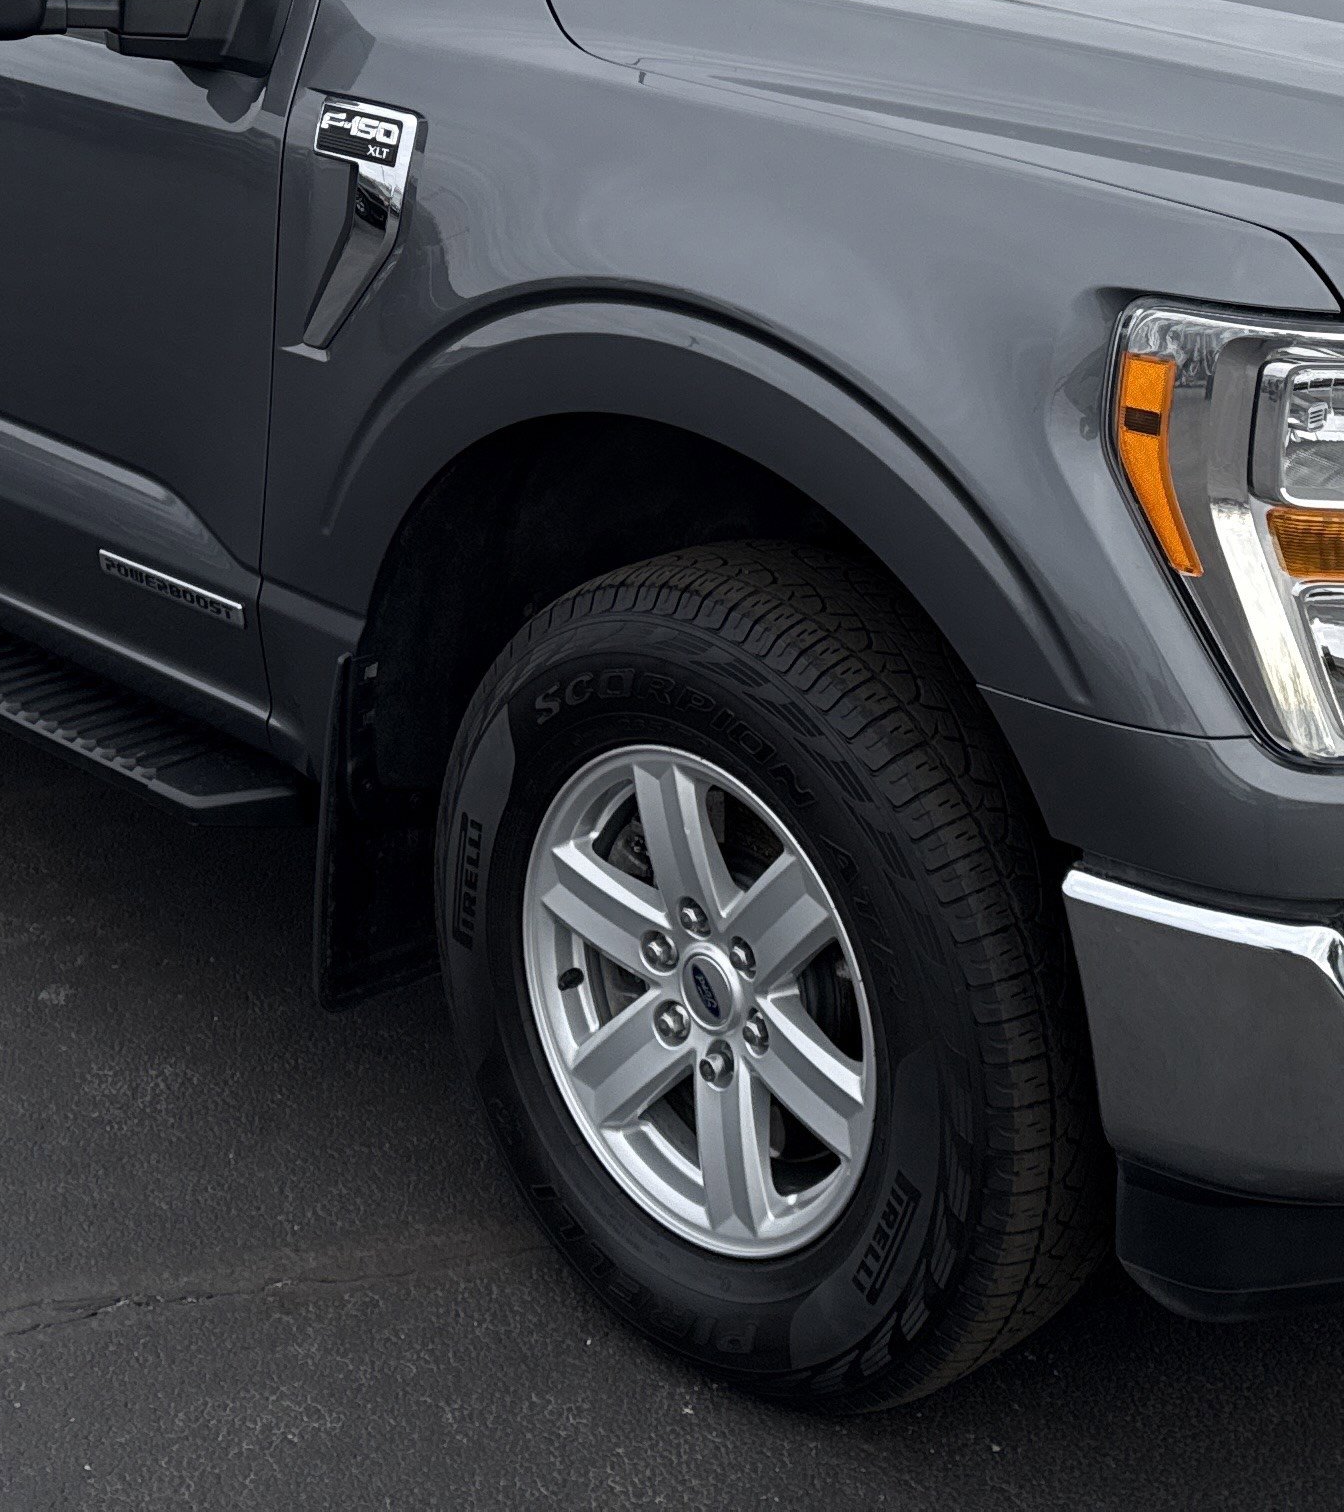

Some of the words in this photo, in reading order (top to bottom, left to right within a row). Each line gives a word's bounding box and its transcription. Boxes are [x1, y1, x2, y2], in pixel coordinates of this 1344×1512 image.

[320, 111, 400, 146] F-150
[366, 144, 390, 160] XLT
[104, 557, 234, 619] POWERBOOST
[535, 667, 816, 808] SCORPION
[452, 812, 483, 951] PIRELLI
[532, 1185, 757, 1354] PIRELLI
[852, 1169, 922, 1307] PIRELLI
